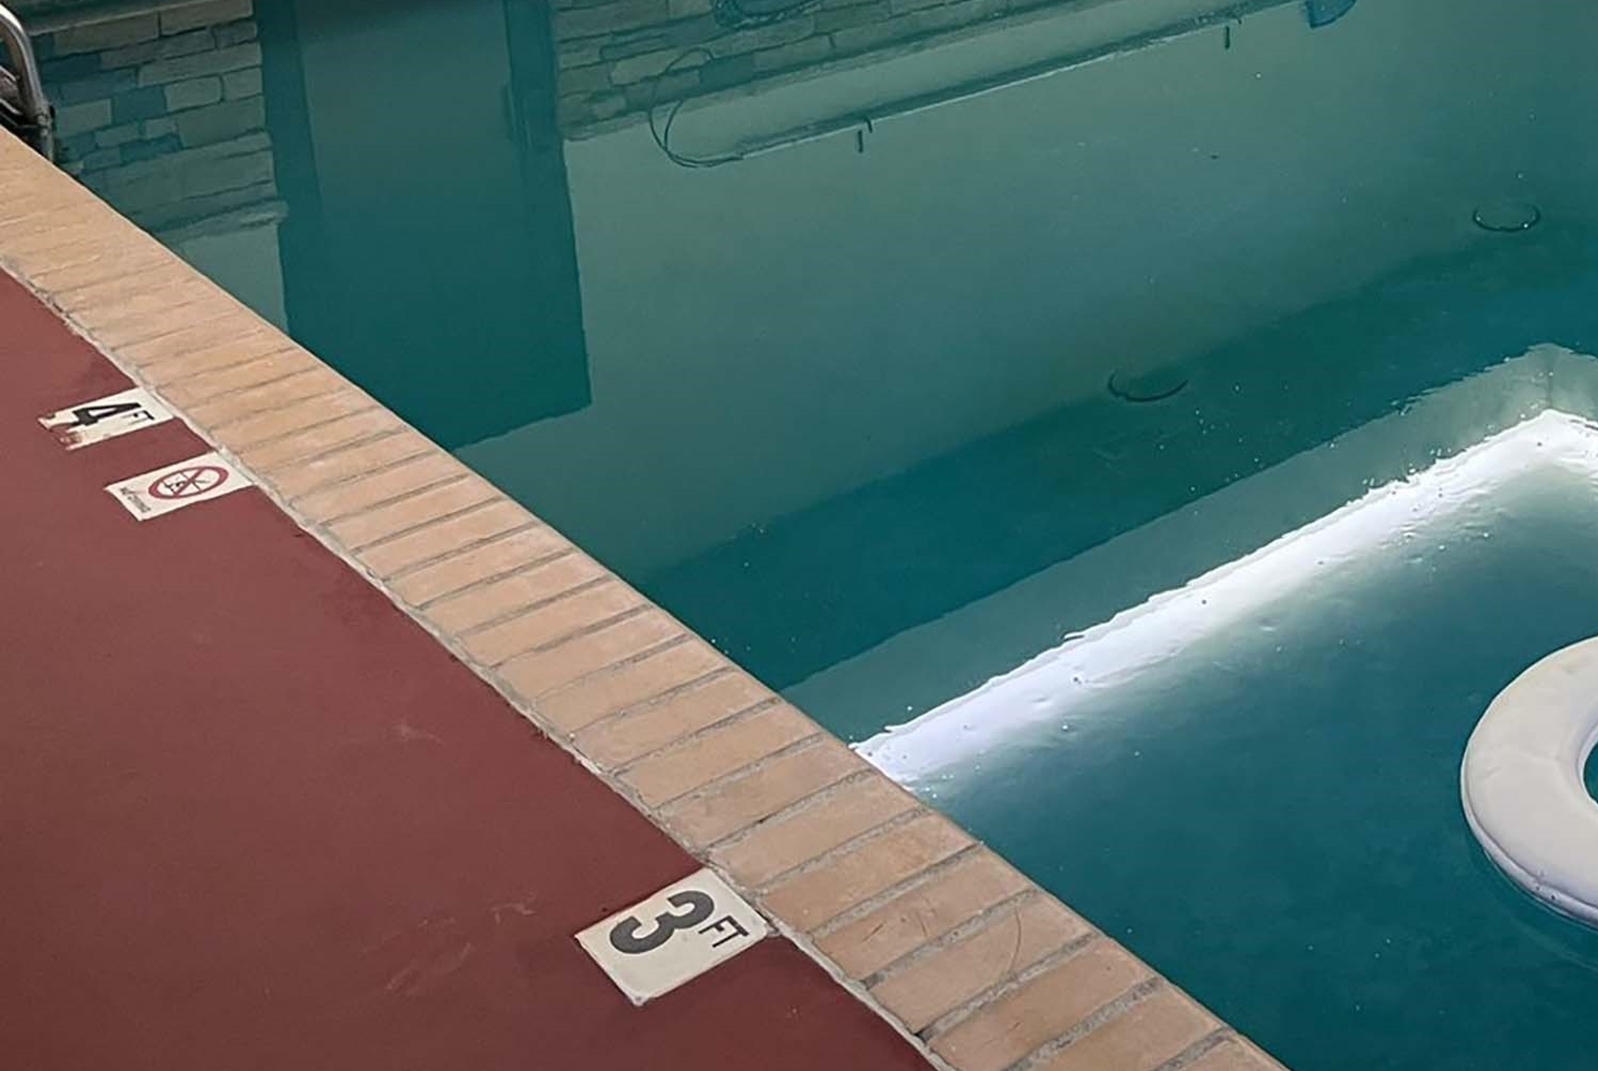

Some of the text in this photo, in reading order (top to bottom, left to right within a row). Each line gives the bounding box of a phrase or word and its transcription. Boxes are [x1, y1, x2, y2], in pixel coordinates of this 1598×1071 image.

[71, 402, 142, 427] 4
[609, 890, 749, 954] 3 FT
